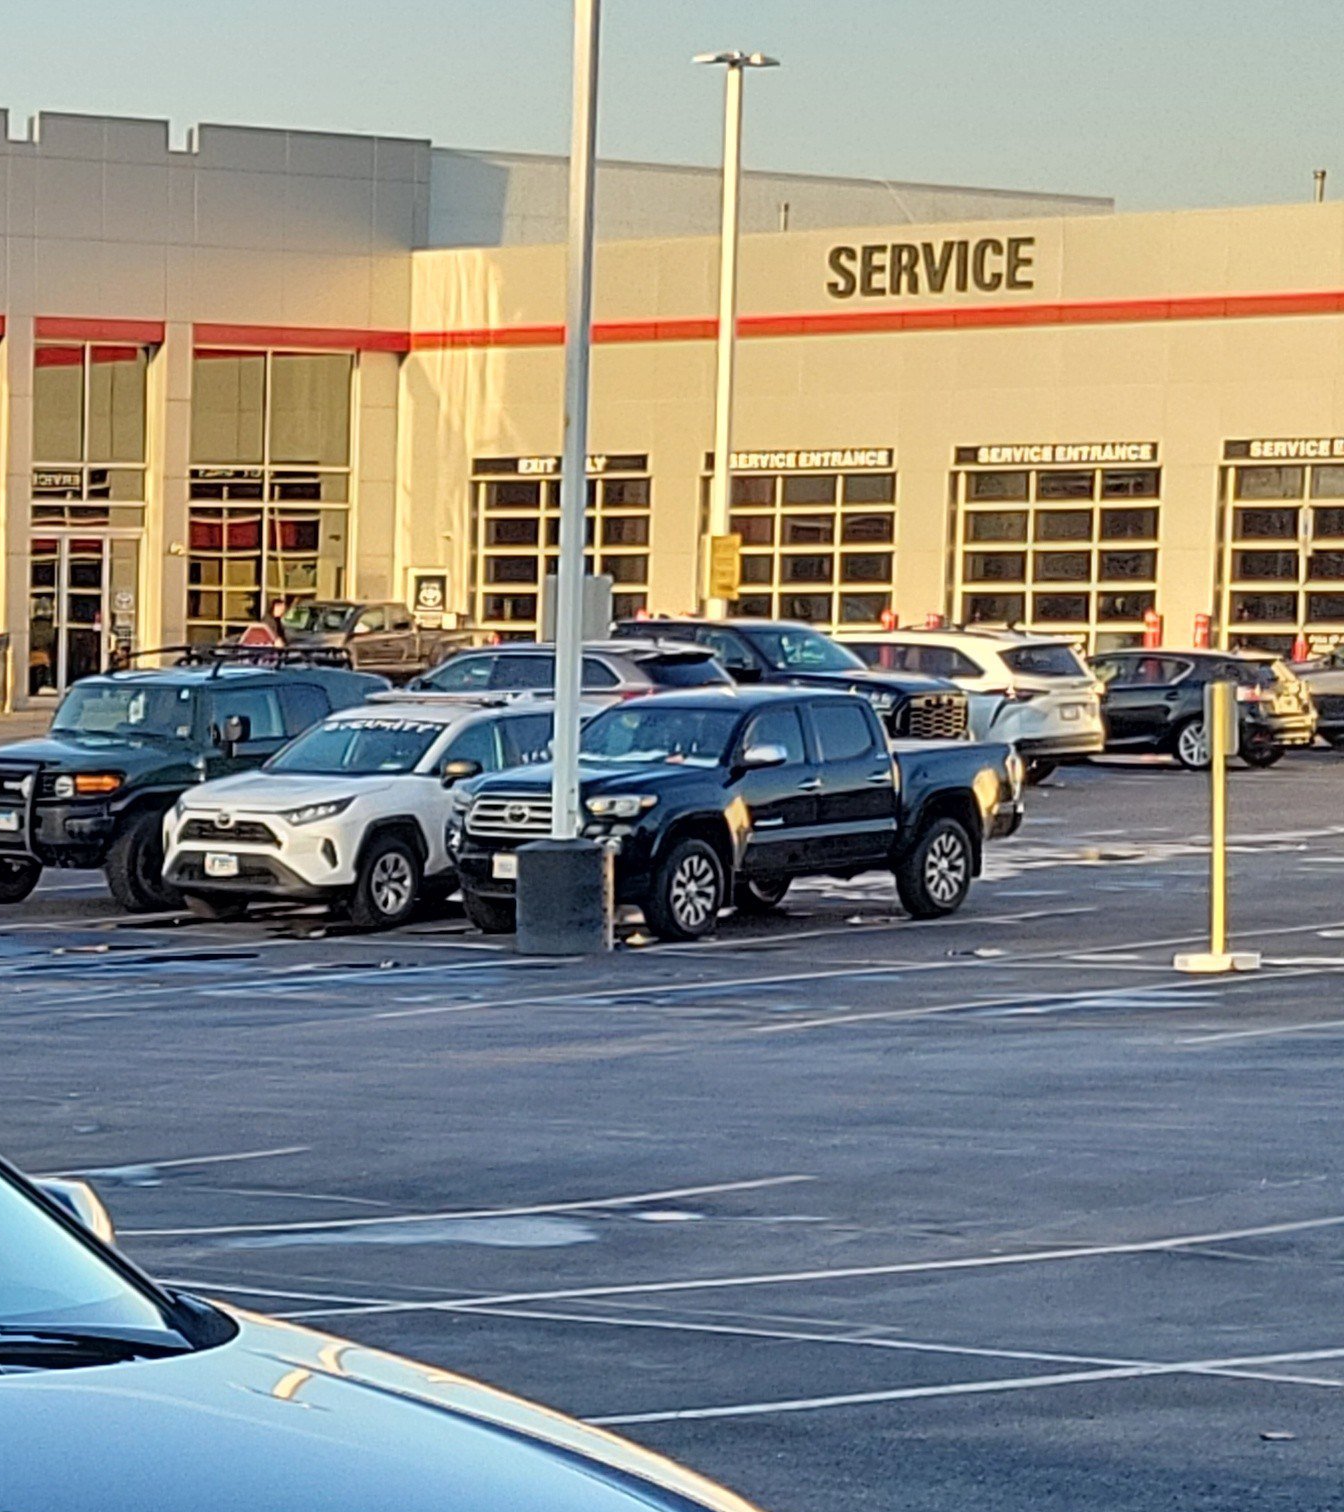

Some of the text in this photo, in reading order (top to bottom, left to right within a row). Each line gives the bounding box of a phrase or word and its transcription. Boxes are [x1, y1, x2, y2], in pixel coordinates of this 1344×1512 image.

[827, 237, 1035, 299] SERVICE
[977, 443, 1152, 463] SERVICE ENTRANCE
[1249, 439, 1330, 458] SERVICE
[518, 456, 607, 473] EXIT LY
[798, 449, 889, 468] ENTRANCE
